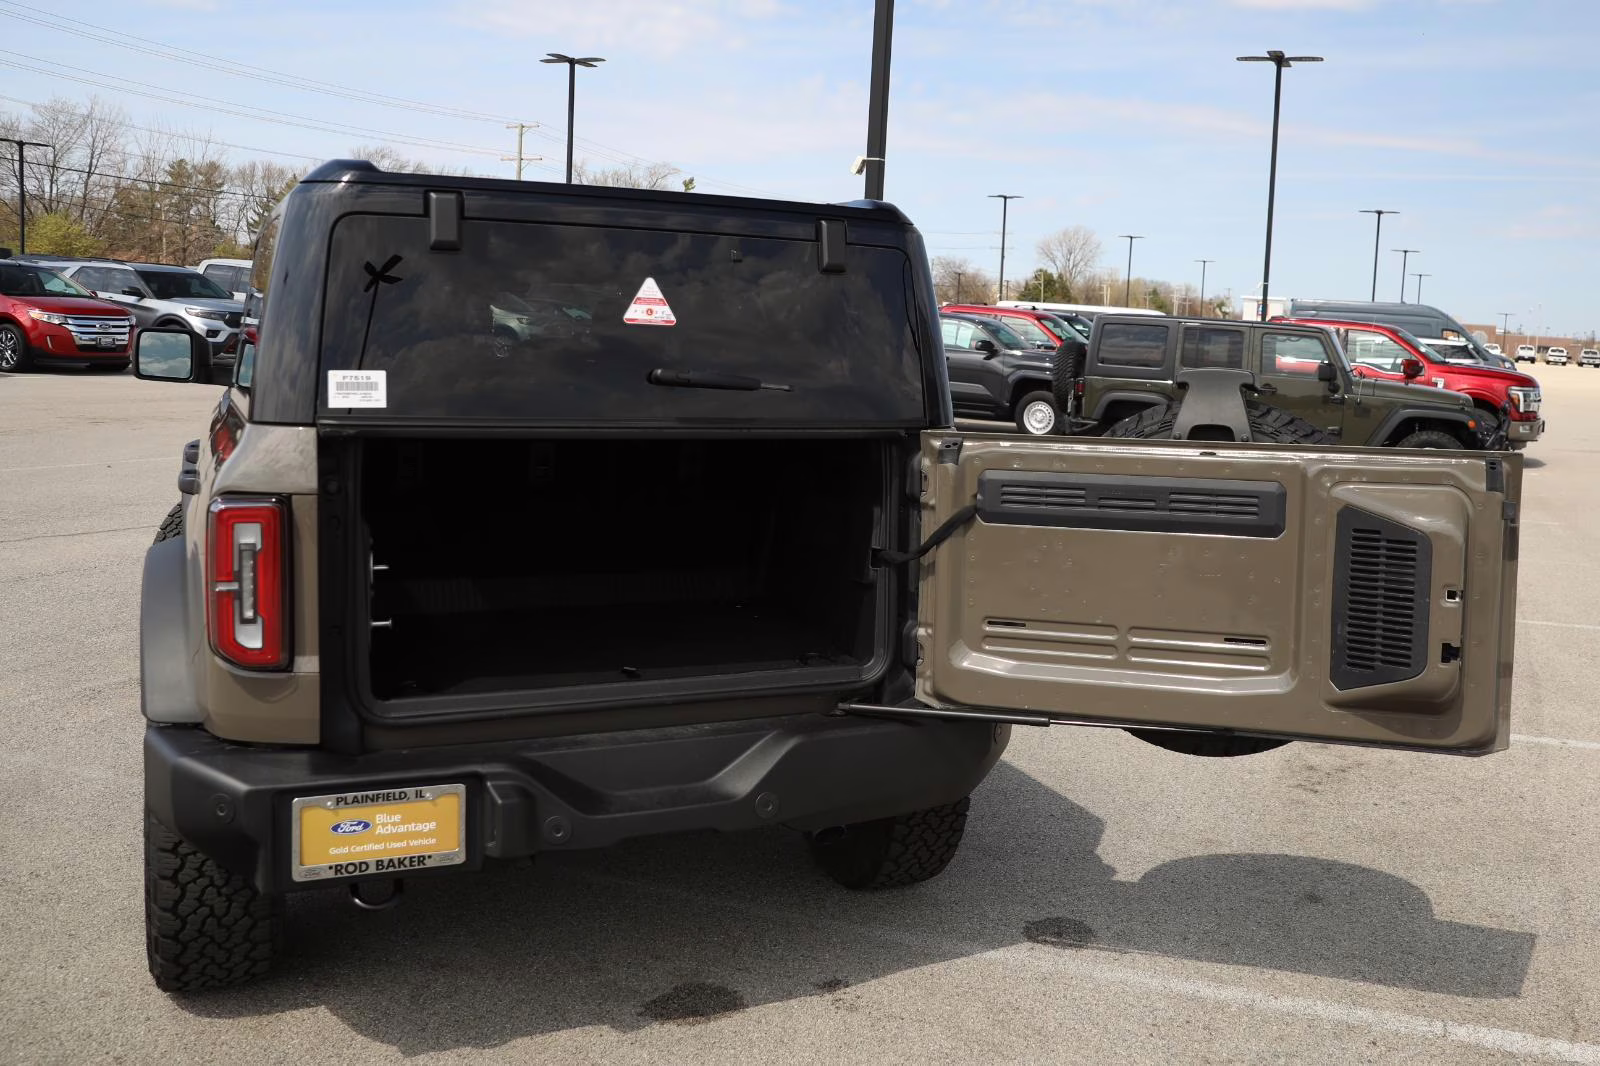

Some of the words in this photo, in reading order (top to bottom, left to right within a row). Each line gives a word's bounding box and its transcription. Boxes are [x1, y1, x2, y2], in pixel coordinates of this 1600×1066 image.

[335, 790, 411, 807] PLAINFIELD,
[415, 789, 425, 799] IL
[375, 813, 402, 824] Blue
[336, 821, 366, 833] Ford
[375, 820, 437, 835] Advantage
[329, 846, 349, 855] Gold
[351, 842, 385, 853] Certified
[386, 839, 407, 849] Used
[409, 837, 437, 847] Vehicle
